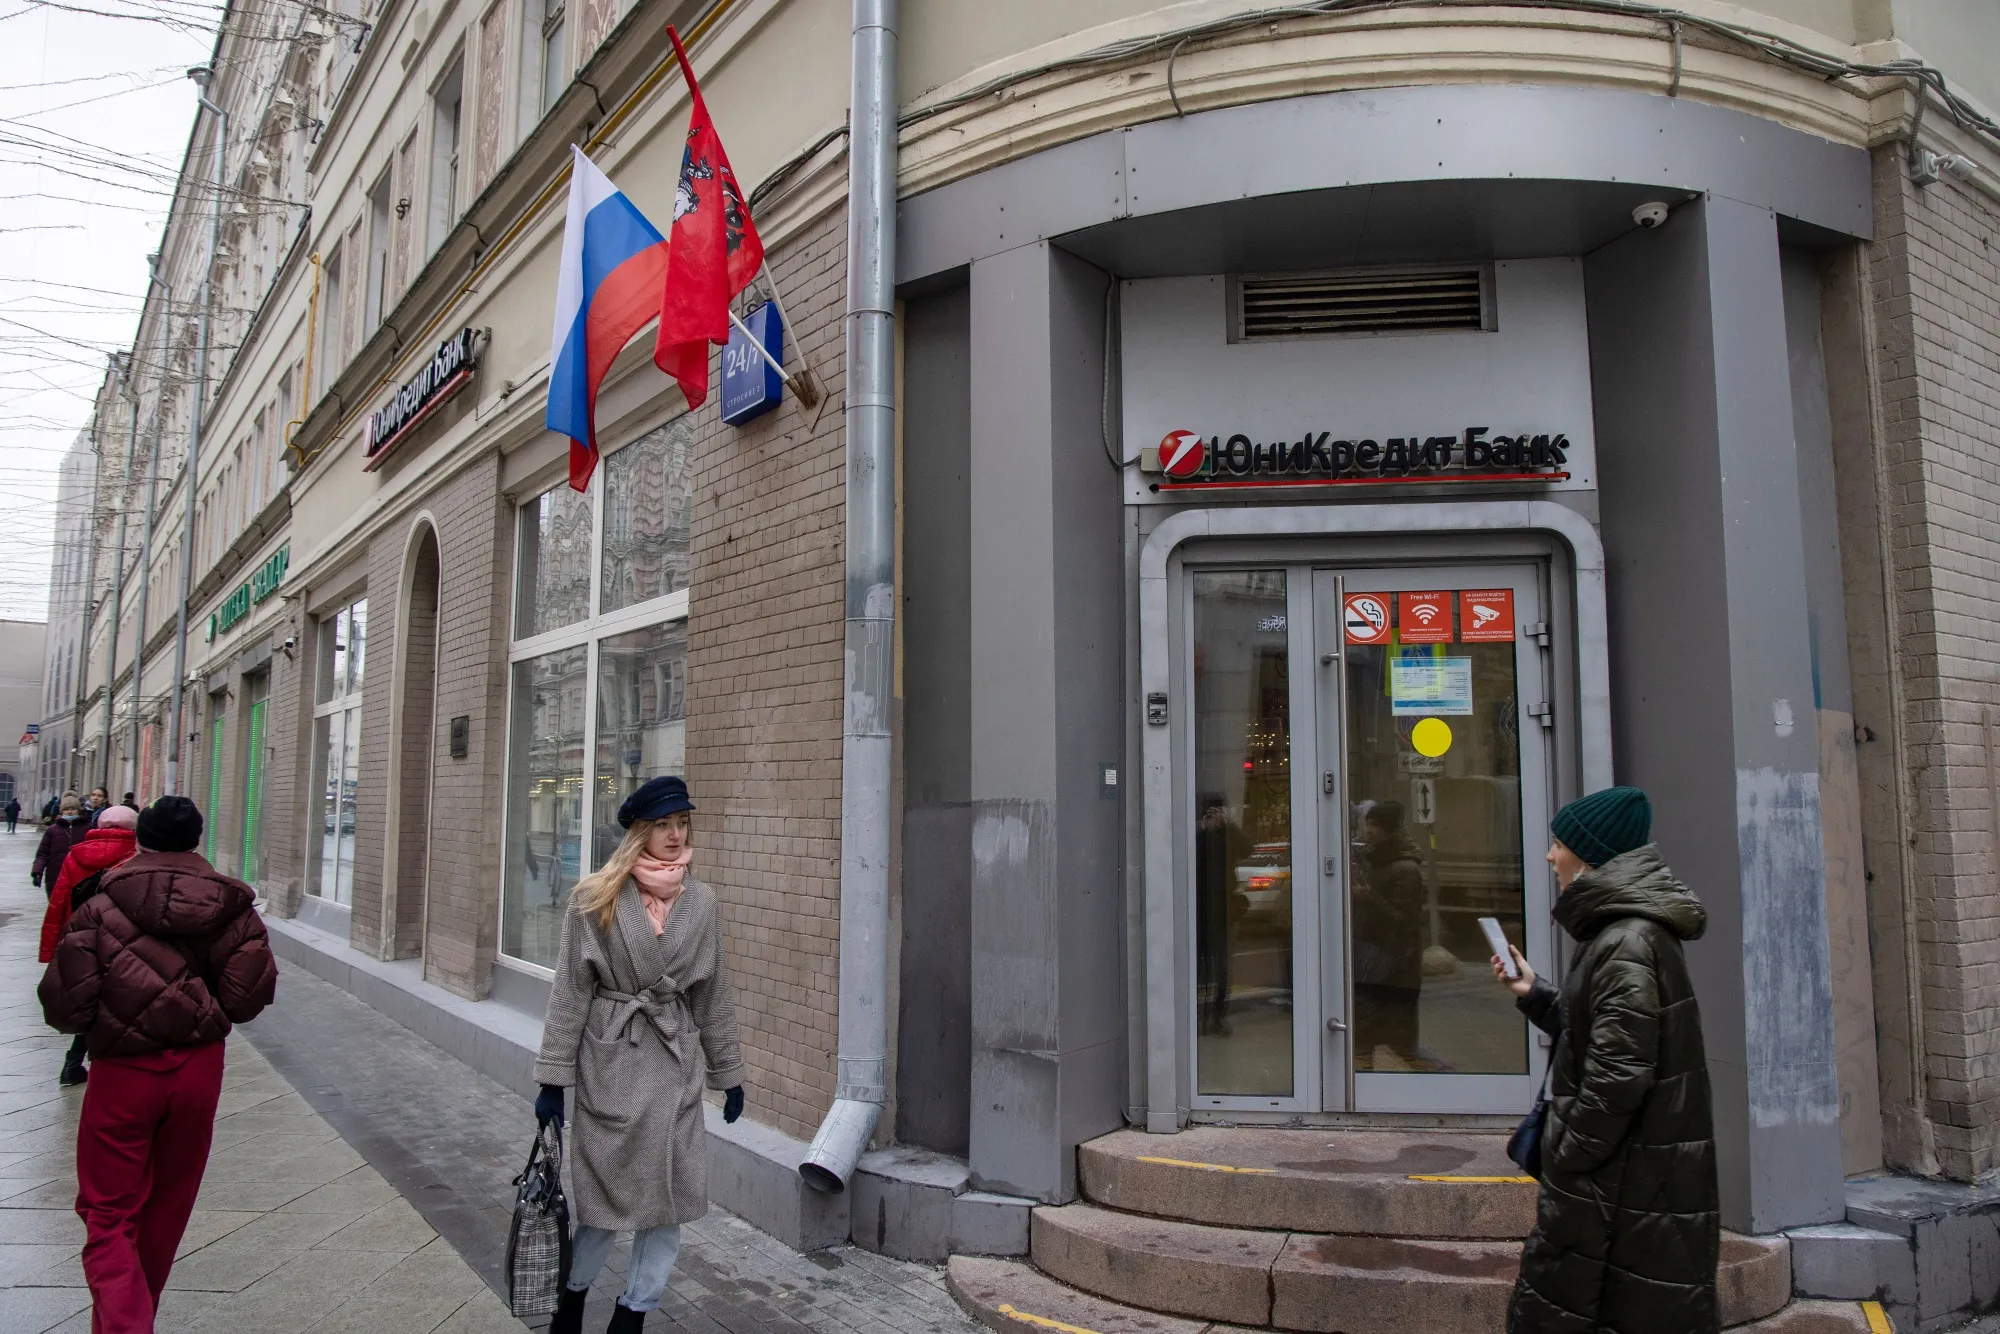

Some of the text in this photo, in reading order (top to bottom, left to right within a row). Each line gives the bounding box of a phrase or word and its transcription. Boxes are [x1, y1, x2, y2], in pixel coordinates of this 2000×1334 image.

[372, 328, 471, 447] ЮниКредит Банк
[727, 387, 755, 408] СТРОЕНИЕ
[1210, 426, 1568, 480] ЮниКредит Банк
